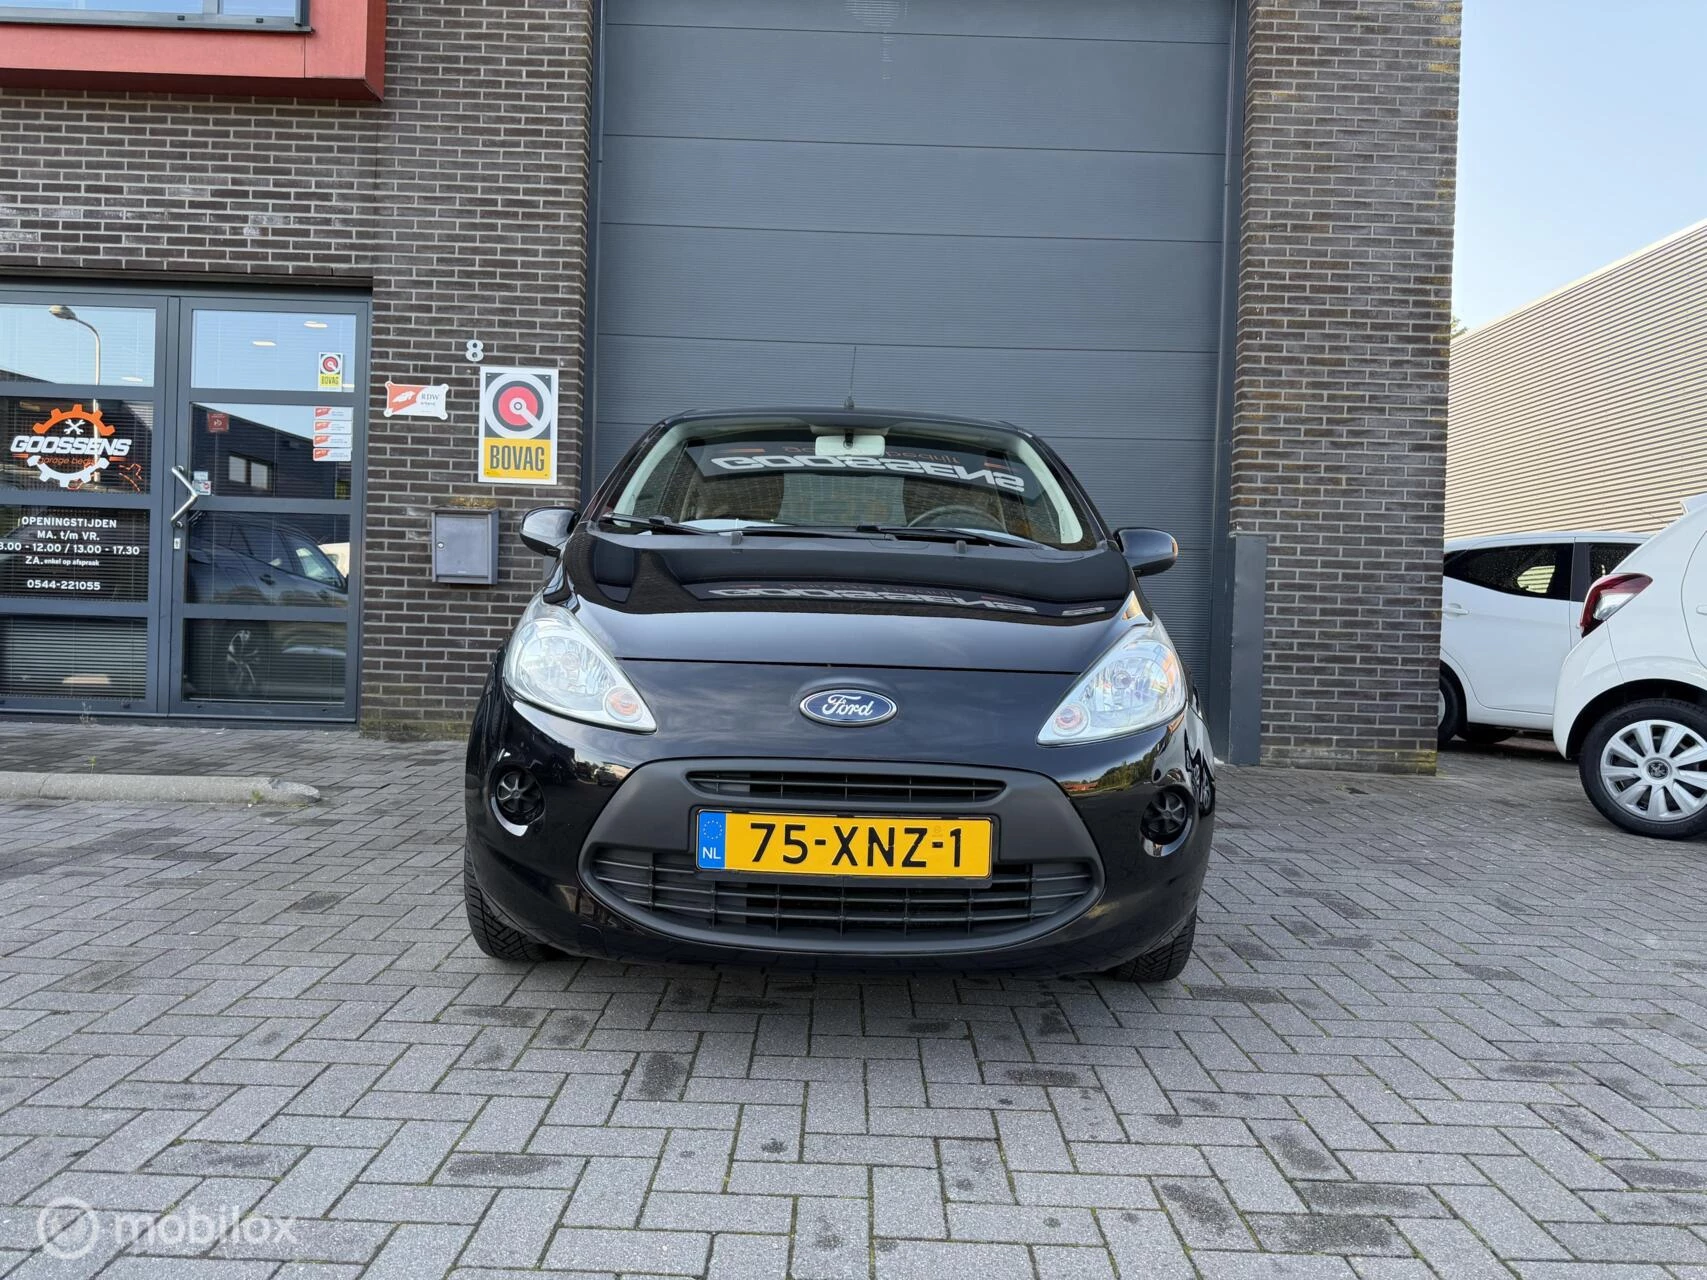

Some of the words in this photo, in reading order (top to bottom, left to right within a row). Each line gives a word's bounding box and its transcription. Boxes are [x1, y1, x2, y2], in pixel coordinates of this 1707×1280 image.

[465, 339, 484, 361] 8
[10, 435, 132, 456] GOOSSENS
[489, 445, 545, 472] BOVAG
[21, 516, 117, 528] OPENINGSTIJDEN
[37, 530, 57, 539] MA.
[60, 531, 78, 540] t/m
[82, 532, 100, 541] VR.
[32, 543, 61, 552] 12.00
[64, 543, 70, 553] /
[73, 544, 101, 554] 13.00
[112, 546, 140, 555] 17.30
[25, 556, 43, 565] ZA.
[27, 580, 101, 590] 0544-221055
[821, 694, 874, 716] Ford
[749, 822, 963, 868] 75-XNZ-1
[702, 847, 722, 860] NL
